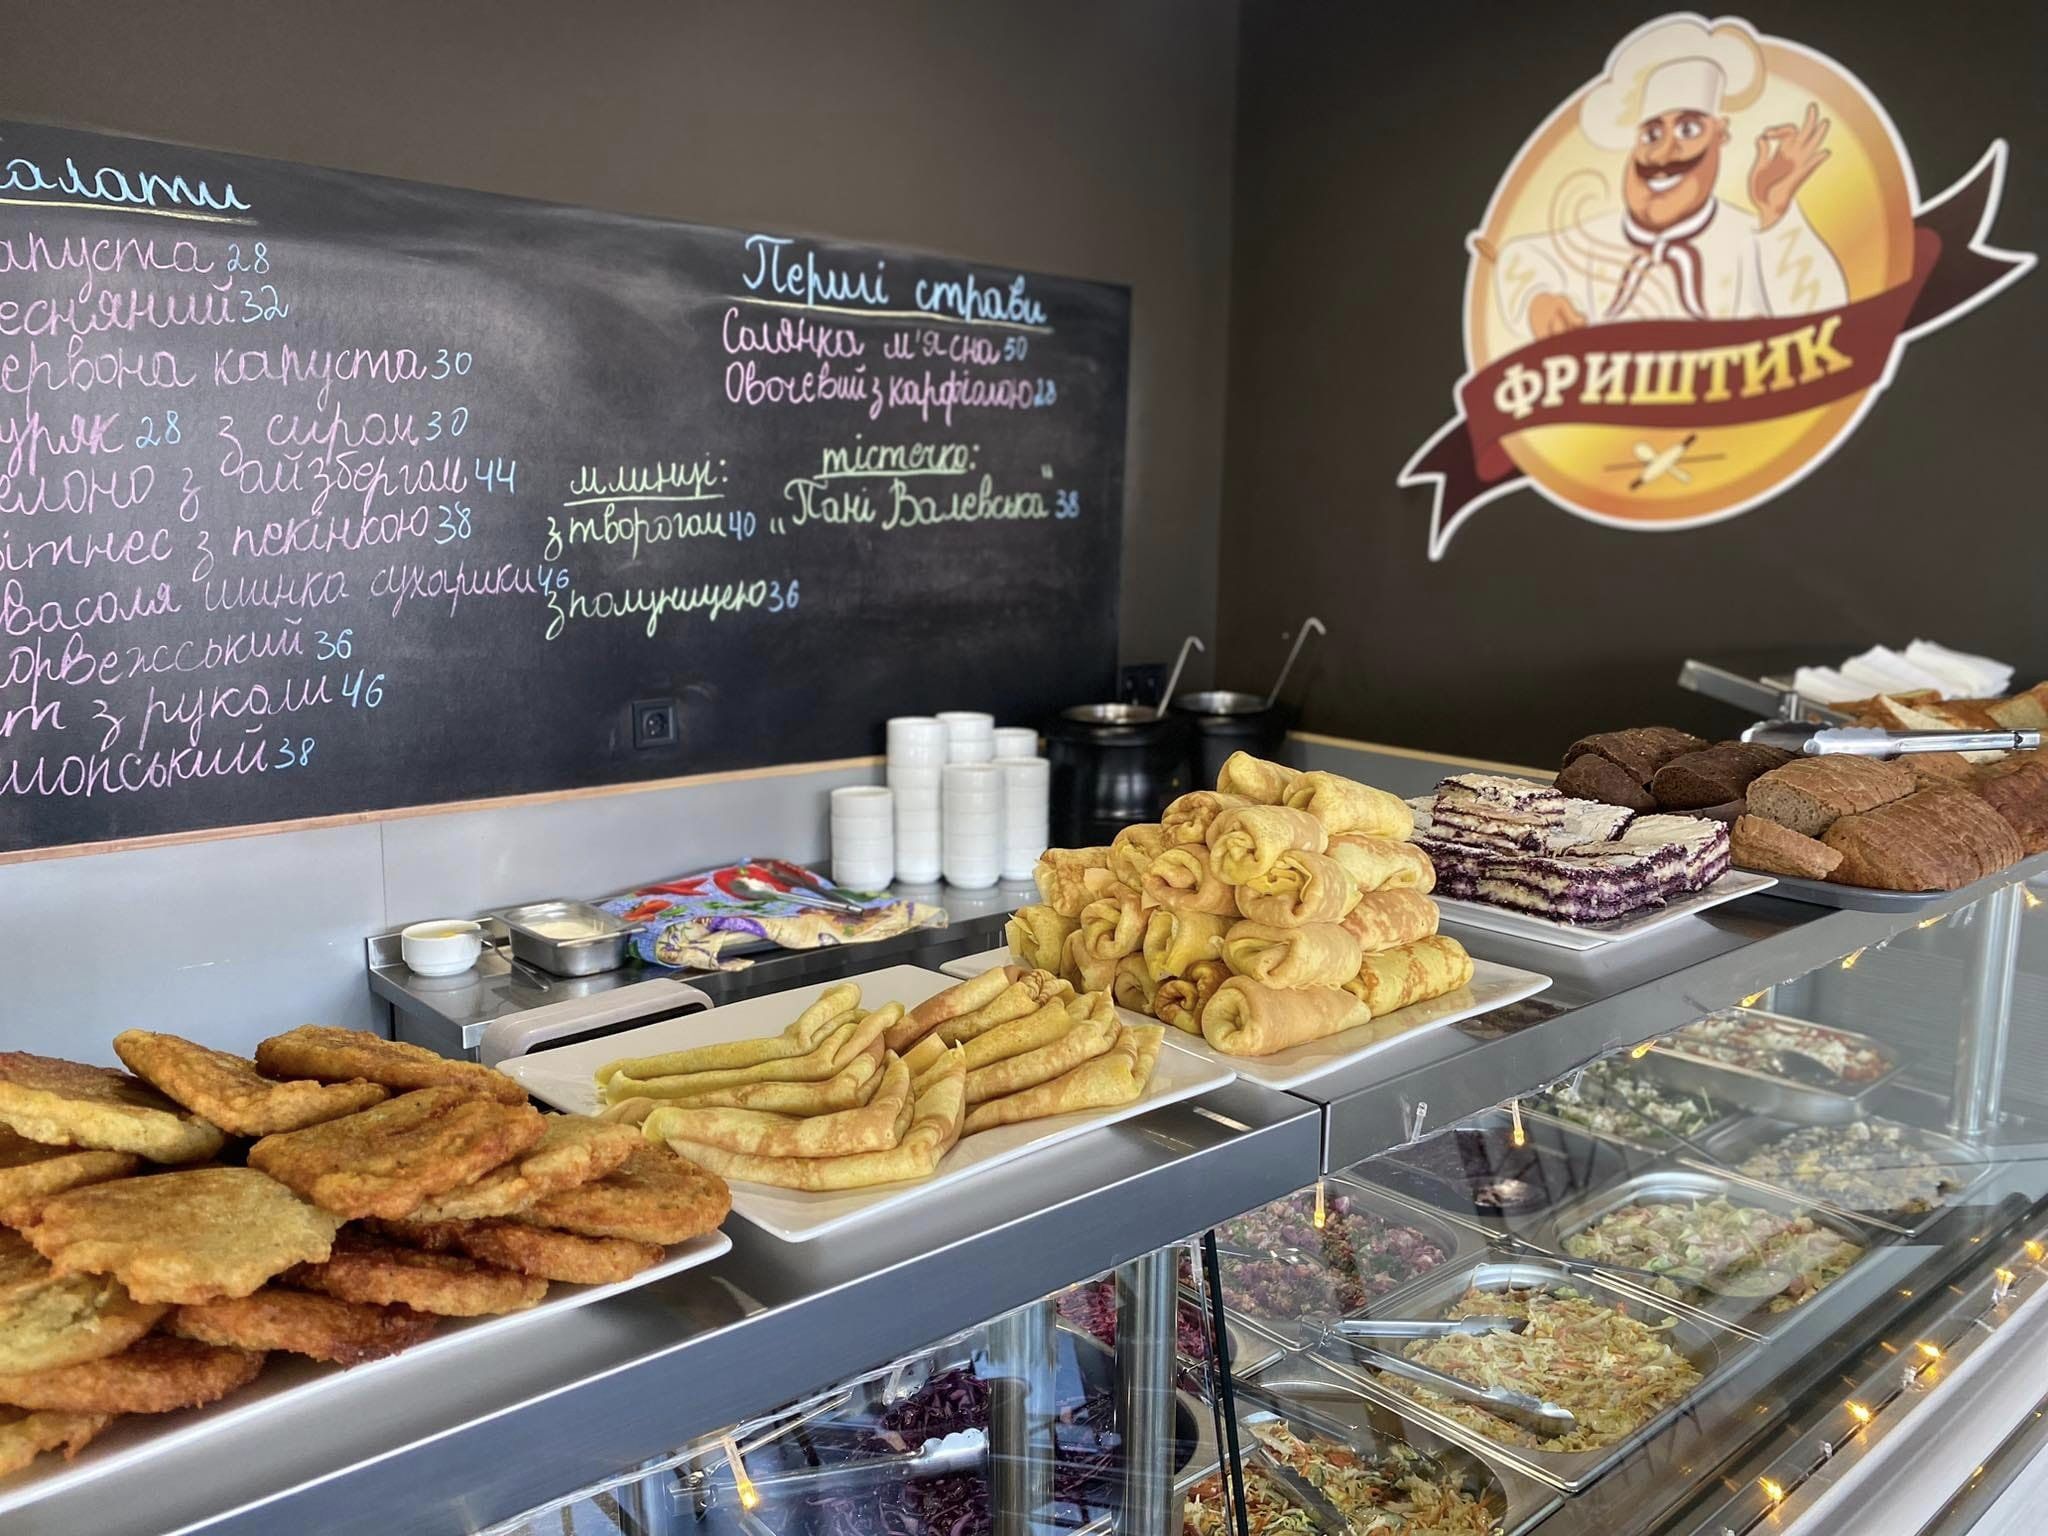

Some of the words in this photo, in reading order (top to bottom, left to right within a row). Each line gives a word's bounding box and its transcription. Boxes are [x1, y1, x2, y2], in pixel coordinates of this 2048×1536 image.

[0, 157, 251, 211] алати
[0, 231, 215, 304] апуста
[227, 241, 270, 275] 28
[743, 234, 889, 308] Перші
[915, 273, 1048, 324] страви
[0, 275, 236, 337] есняний
[240, 284, 289, 322] 32
[0, 333, 197, 422] ервона
[214, 344, 428, 412] капуста
[431, 349, 473, 380] 30
[1003, 336, 1028, 362] 50
[1493, 314, 1854, 420] ФРИШТИК
[725, 360, 868, 407] Овочевий
[0, 411, 124, 478] уряк
[135, 409, 181, 449] 28
[216, 415, 244, 477] з
[424, 406, 469, 441] 30
[822, 432, 980, 476] тістечко:
[179, 466, 202, 523] з
[475, 456, 517, 494] 44
[569, 451, 729, 498] млинці:
[728, 509, 757, 542] 40
[1055, 488, 1081, 520] 38
[0, 527, 173, 571] ітнес
[191, 530, 215, 583] з
[232, 505, 430, 557] пекінкою
[433, 501, 472, 545] 38
[0, 578, 183, 636] васоля
[536, 563, 571, 597] 46
[767, 578, 800, 613] 36
[314, 628, 354, 662] 36
[91, 699, 127, 753] з
[340, 668, 385, 709] 46
[273, 737, 315, 769] 38
